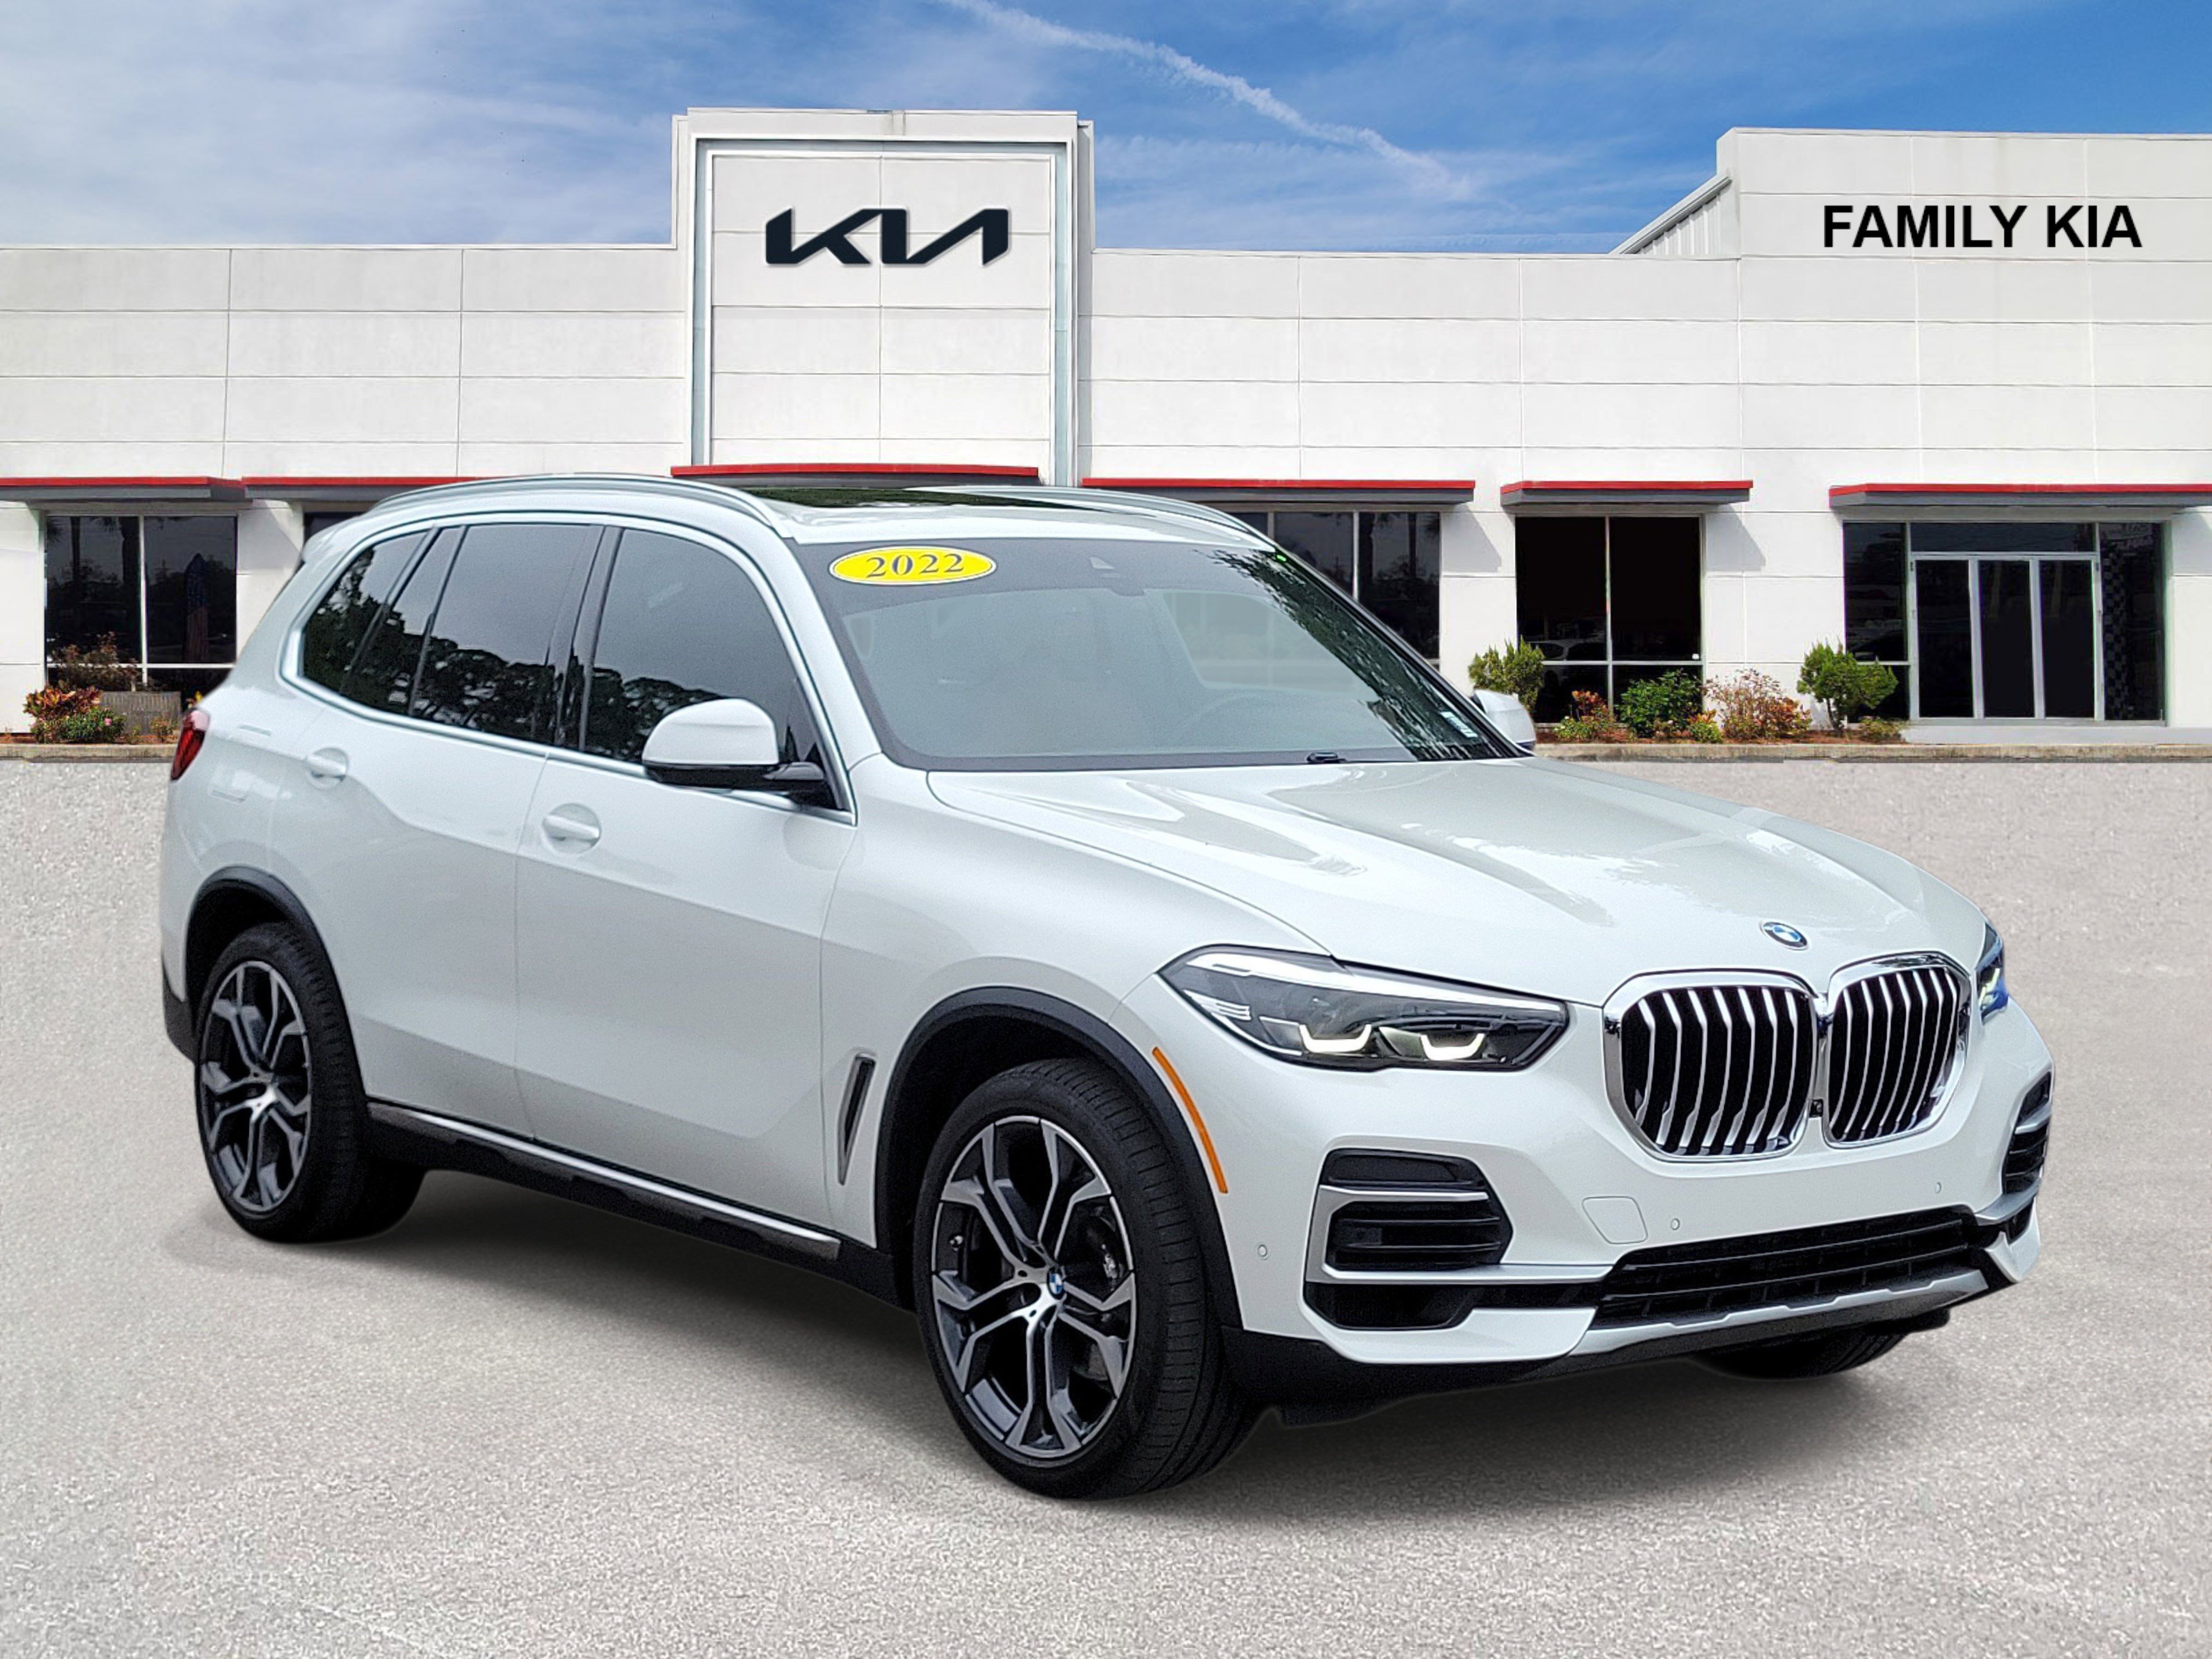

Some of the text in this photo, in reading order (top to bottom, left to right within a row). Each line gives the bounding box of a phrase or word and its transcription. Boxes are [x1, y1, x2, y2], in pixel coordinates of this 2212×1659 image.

[765, 208, 1009, 266] KIA
[1824, 205, 2143, 248] FAMILY KIA
[866, 553, 964, 578] 2022
